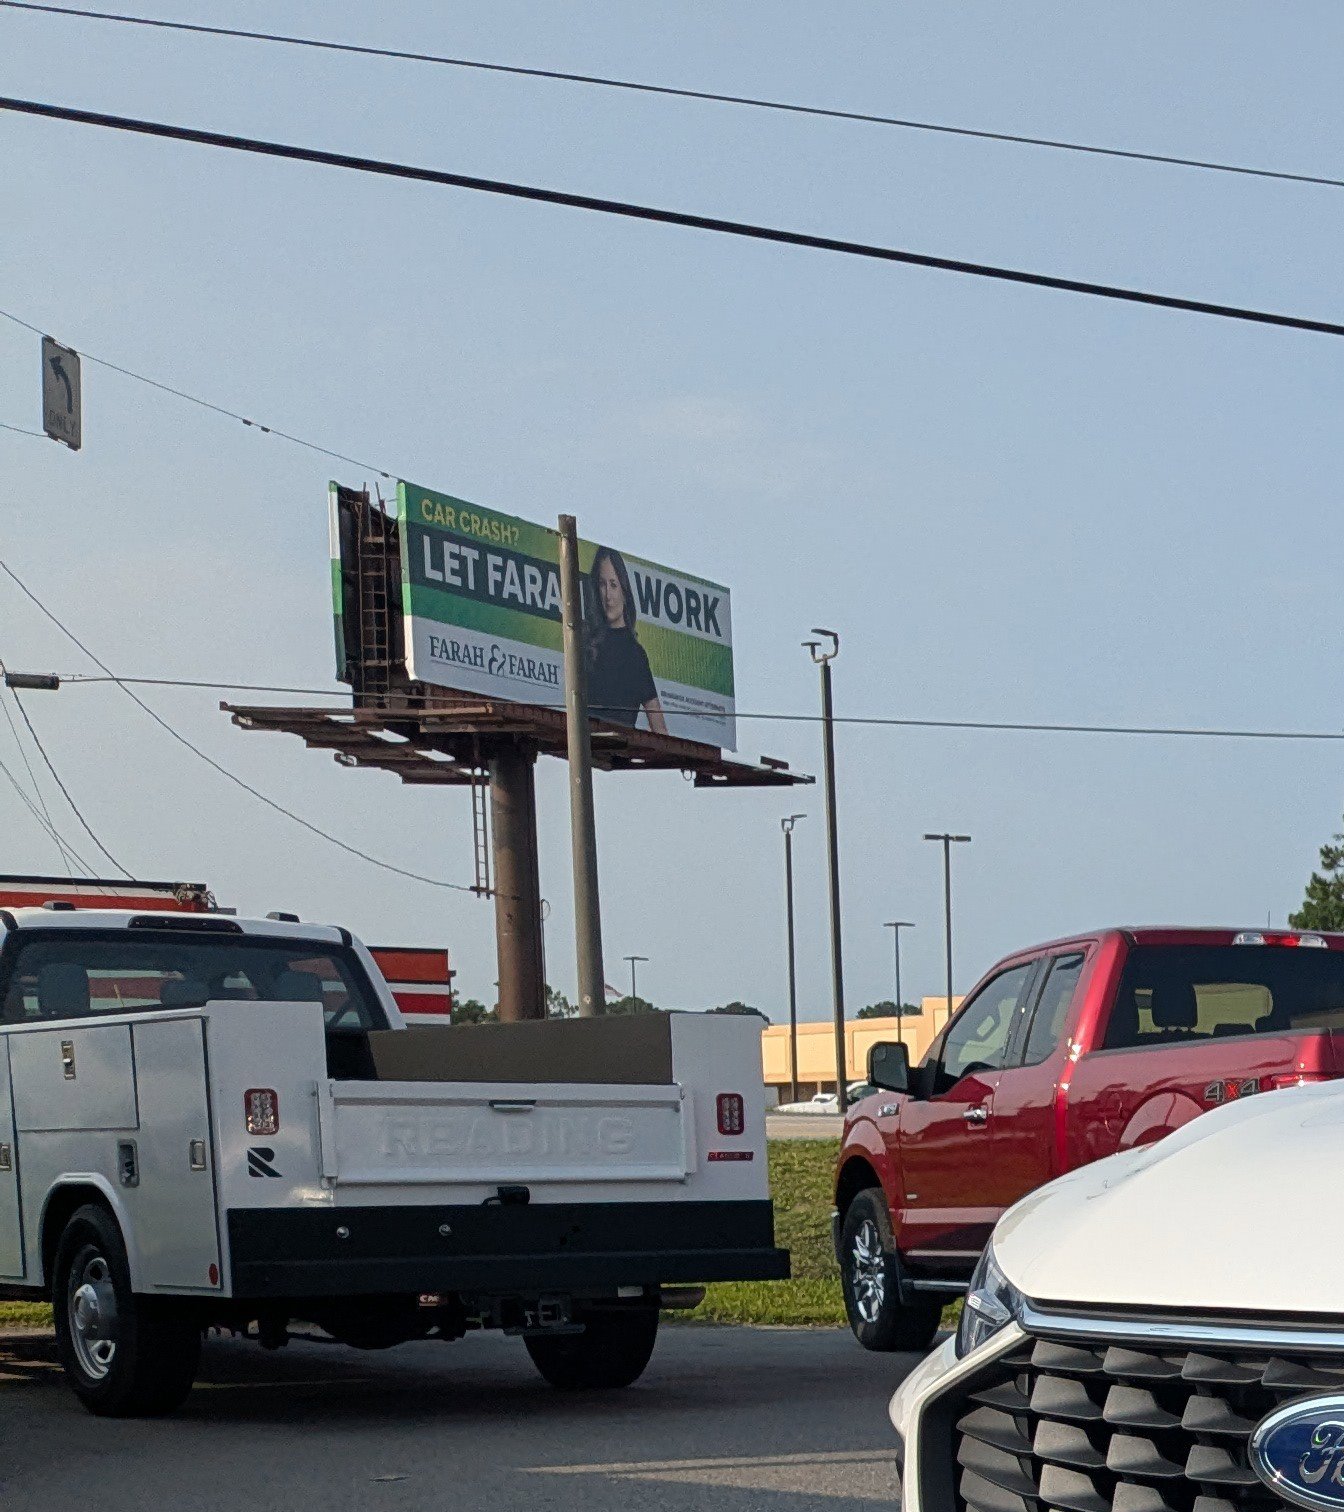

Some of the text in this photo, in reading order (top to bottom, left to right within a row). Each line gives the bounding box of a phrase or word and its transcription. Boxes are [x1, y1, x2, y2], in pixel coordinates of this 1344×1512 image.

[421, 499, 520, 546] CAR CRASH?
[423, 534, 722, 638] LET FARA WORK
[429, 635, 560, 685] FARAH & FARAH
